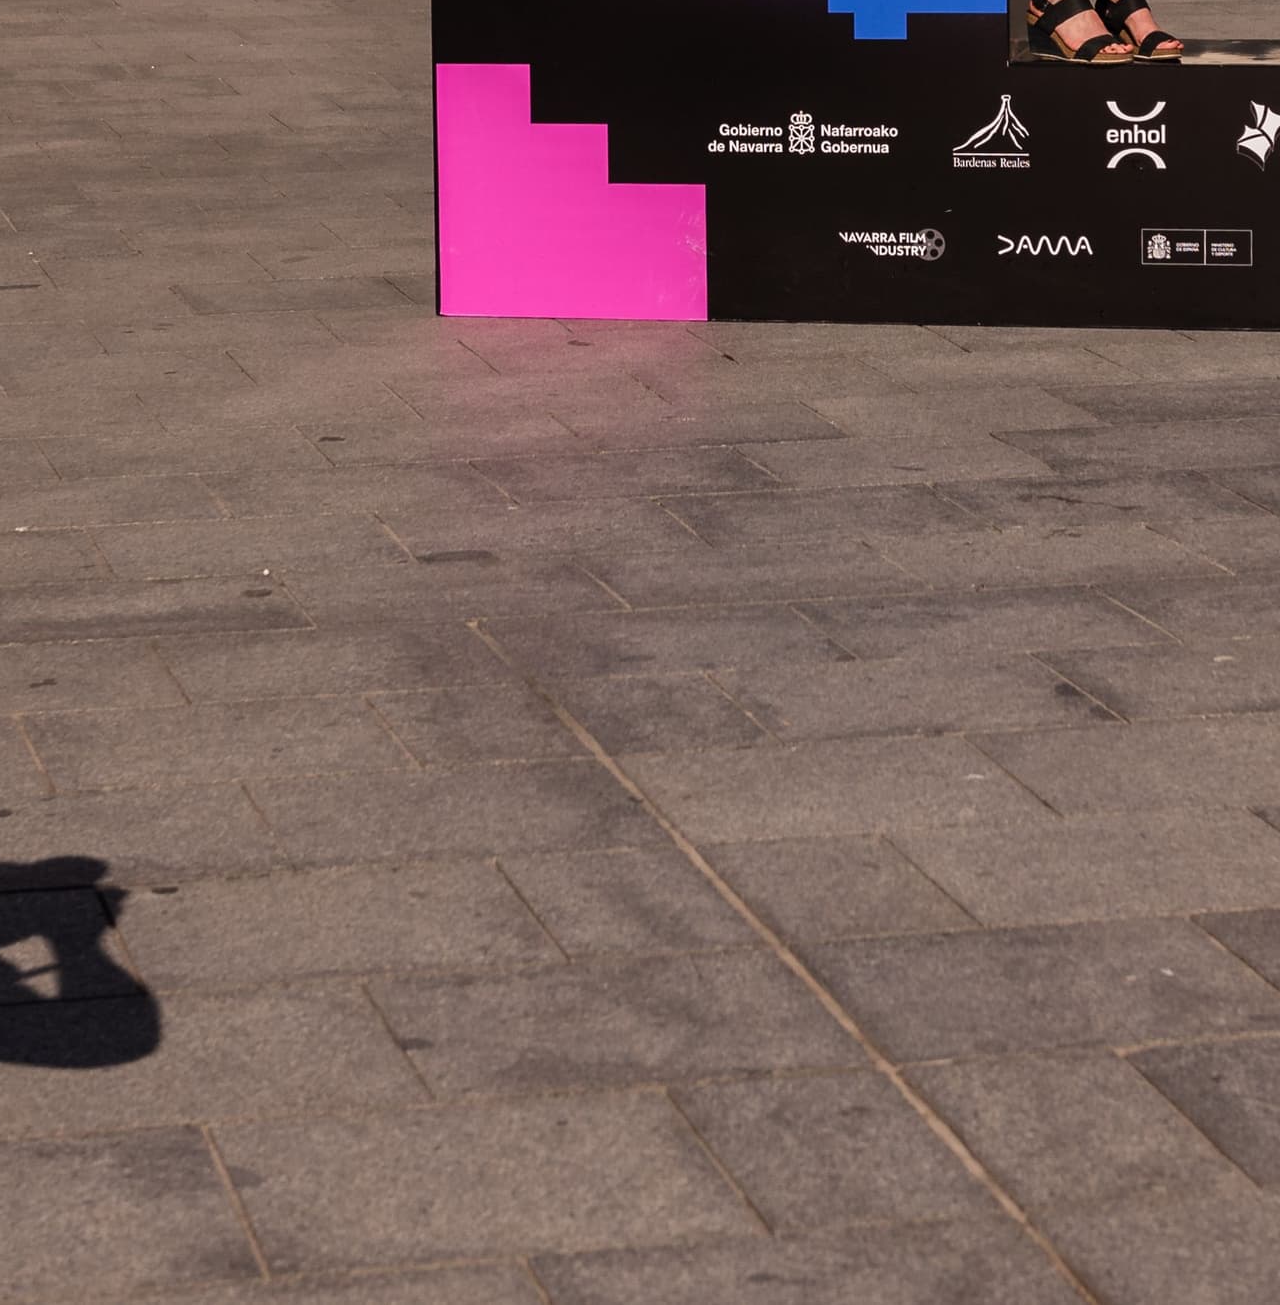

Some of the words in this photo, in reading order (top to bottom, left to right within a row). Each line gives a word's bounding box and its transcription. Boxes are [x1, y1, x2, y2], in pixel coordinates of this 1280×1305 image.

[719, 123, 783, 137] Gobierno
[820, 124, 898, 138] Nafarroako
[1106, 124, 1166, 145] enhol
[708, 140, 725, 153] de
[729, 140, 783, 153] Navarra
[821, 141, 889, 154] Gobernua
[953, 157, 997, 168] Bardenas
[1000, 158, 1031, 168] Reales
[839, 232, 897, 243] NAVARRA
[899, 232, 927, 244] FILM
[866, 245, 927, 257] INDUSTRY
